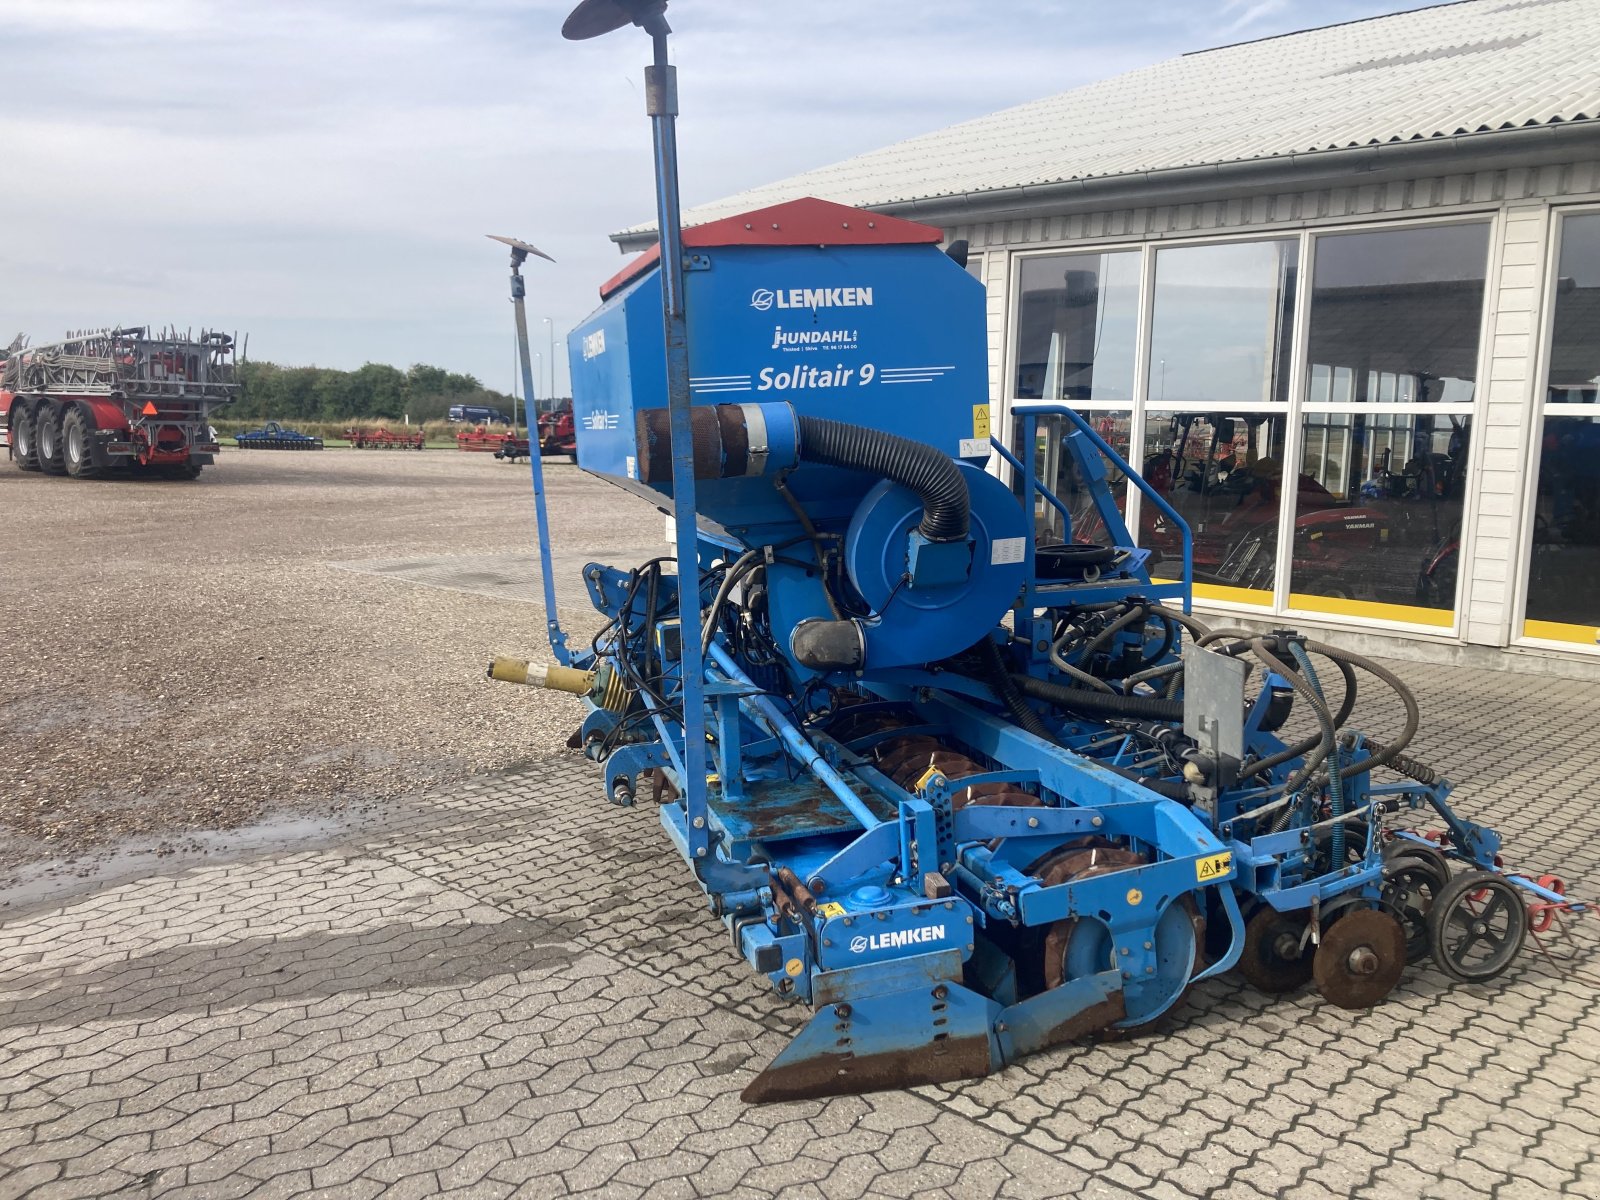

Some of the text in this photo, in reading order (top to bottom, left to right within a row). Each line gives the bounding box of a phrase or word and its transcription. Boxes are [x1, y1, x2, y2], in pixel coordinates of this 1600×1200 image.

[777, 287, 873, 312] LEMKEN
[757, 363, 875, 391] Solitair 9
[869, 925, 945, 949] LEMKEN
